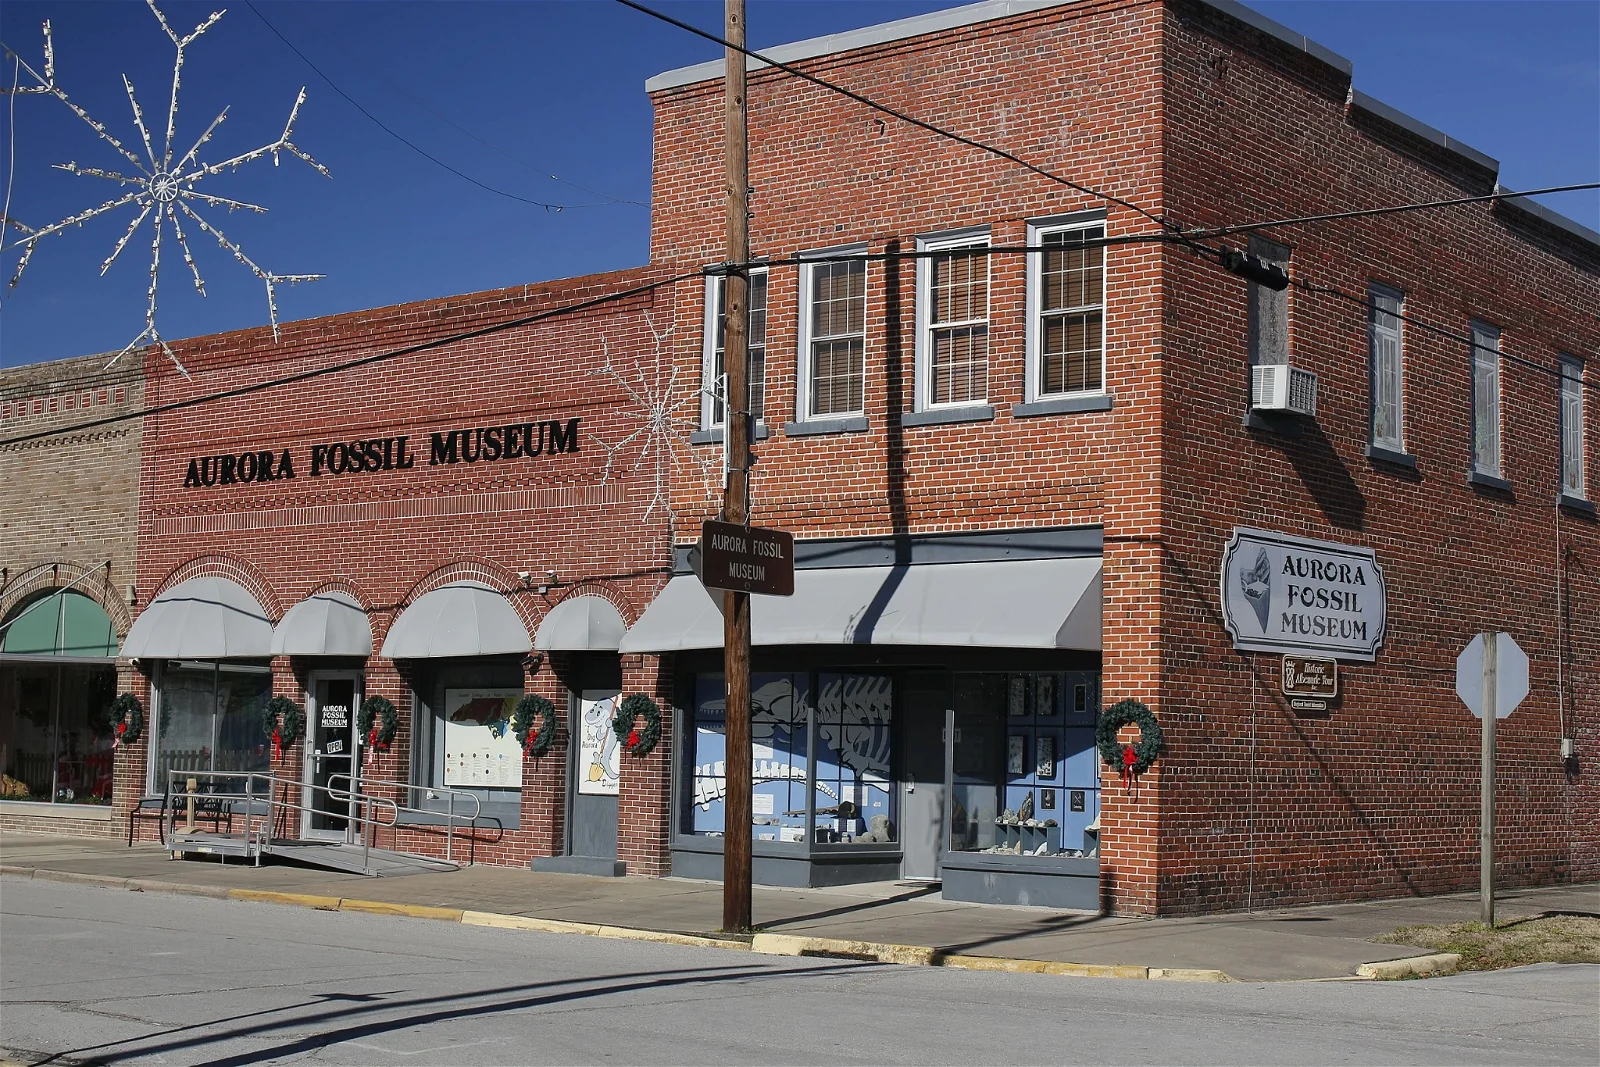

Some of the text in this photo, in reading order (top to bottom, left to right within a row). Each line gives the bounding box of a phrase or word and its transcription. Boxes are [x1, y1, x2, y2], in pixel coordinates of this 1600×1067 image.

[183, 418, 581, 487] AURORA FOSSIL MUSEUM
[711, 534, 784, 559] AURORA FOSSIL
[729, 562, 765, 581] MUSEUM
[1281, 555, 1367, 586] AURORA
[1287, 584, 1363, 613] FOSSIL
[1281, 612, 1367, 641] MUSEUM
